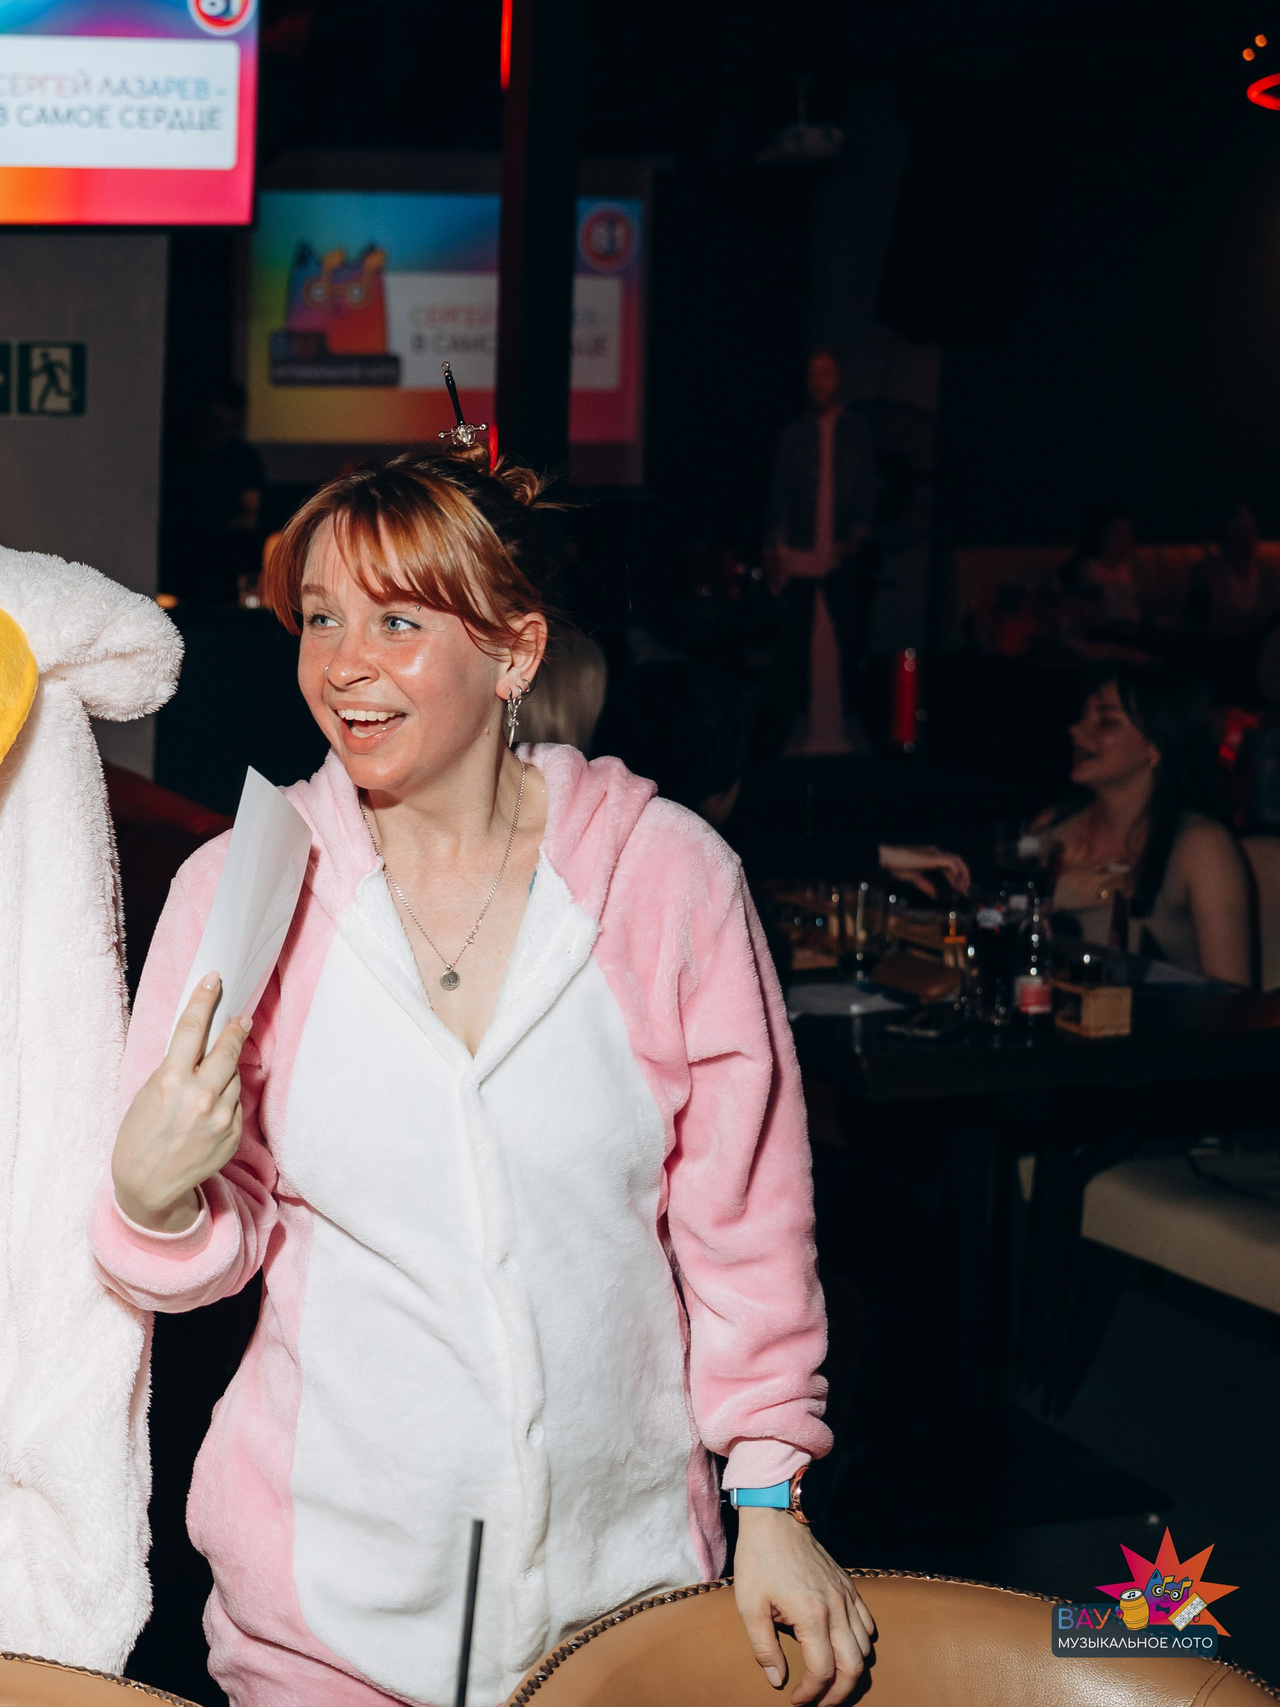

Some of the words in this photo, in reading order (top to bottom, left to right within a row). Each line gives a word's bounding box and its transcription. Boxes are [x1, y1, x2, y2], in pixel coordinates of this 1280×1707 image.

[98, 75, 210, 99] ЛАЗАРЕВ
[16, 103, 112, 129] САМОЕ
[117, 104, 223, 131] СЕРДЦЕ
